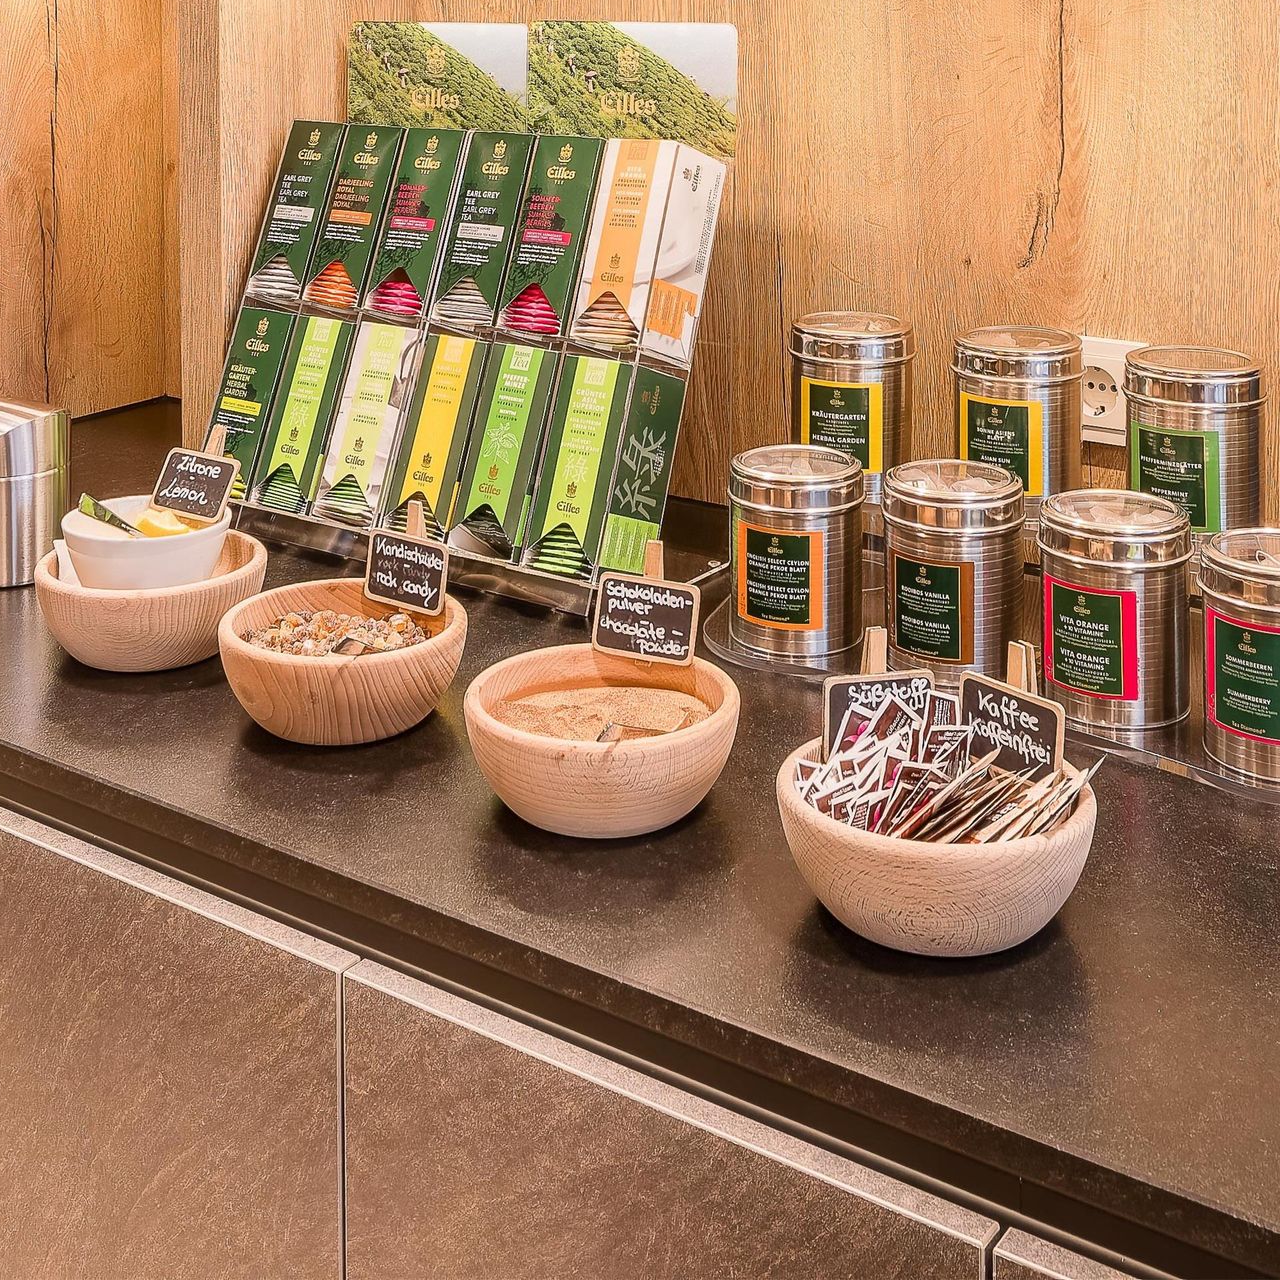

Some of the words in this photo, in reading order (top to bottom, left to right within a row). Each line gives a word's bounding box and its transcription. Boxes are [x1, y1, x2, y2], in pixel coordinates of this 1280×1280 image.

[411, 88, 461, 110] Eilles
[600, 91, 658, 117] Eilles
[283, 174, 297, 182] EARL
[297, 175, 313, 183] GREY
[338, 179, 374, 188] DARJEELING
[279, 189, 292, 197] EARL
[293, 190, 309, 198] GREY
[337, 186, 355, 194] ROYAL
[466, 189, 482, 198] EARL
[482, 190, 501, 199] GREY
[334, 193, 370, 203] DARJEELING
[464, 197, 476, 206] TEE
[462, 205, 478, 213] EARL
[478, 206, 497, 215] GREY
[460, 213, 472, 221] TEA
[230, 363, 258, 375] KRÄUTER-
[228, 372, 251, 382] GARTEN
[224, 388, 248, 398] GARDEN
[811, 410, 866, 421] KRÄUTERGARTEN
[976, 426, 995, 435] SONNE
[812, 433, 836, 443] HERBAL
[836, 437, 866, 445] GARDEN
[980, 454, 997, 463] ASIAN
[176, 456, 222, 479] Zitrone
[160, 477, 208, 505] Lemon
[1150, 486, 1189, 498] PEPPERMINT
[748, 560, 769, 570] ORANGE
[769, 564, 788, 572] PEKOE
[767, 557, 786, 566] SELECT
[786, 559, 810, 567] CEYLON
[402, 580, 438, 607] candy
[606, 581, 693, 609] Schokoladen-
[748, 587, 769, 597] ORANGE
[769, 591, 788, 600] PEKOE
[767, 584, 786, 593] SELECT
[786, 586, 809, 594] CEYLON
[901, 584, 924, 596] ROOIBOS
[924, 591, 950, 600] VANILLA
[608, 598, 653, 615] pulver
[901, 614, 924, 626] ROOIBOS
[924, 621, 951, 630] VANILLA
[1059, 613, 1075, 625] VITA
[1075, 619, 1110, 632] ORANGE
[1073, 627, 1104, 638] VITAMINE
[1059, 647, 1075, 659] VITA
[1076, 652, 1110, 665] ORANGE
[1074, 660, 1105, 671] VITAMINS
[1225, 653, 1273, 672] SOMMERBEEREN
[1226, 688, 1272, 706] SUMMERBERRY
[977, 689, 1040, 733] Kaffee
